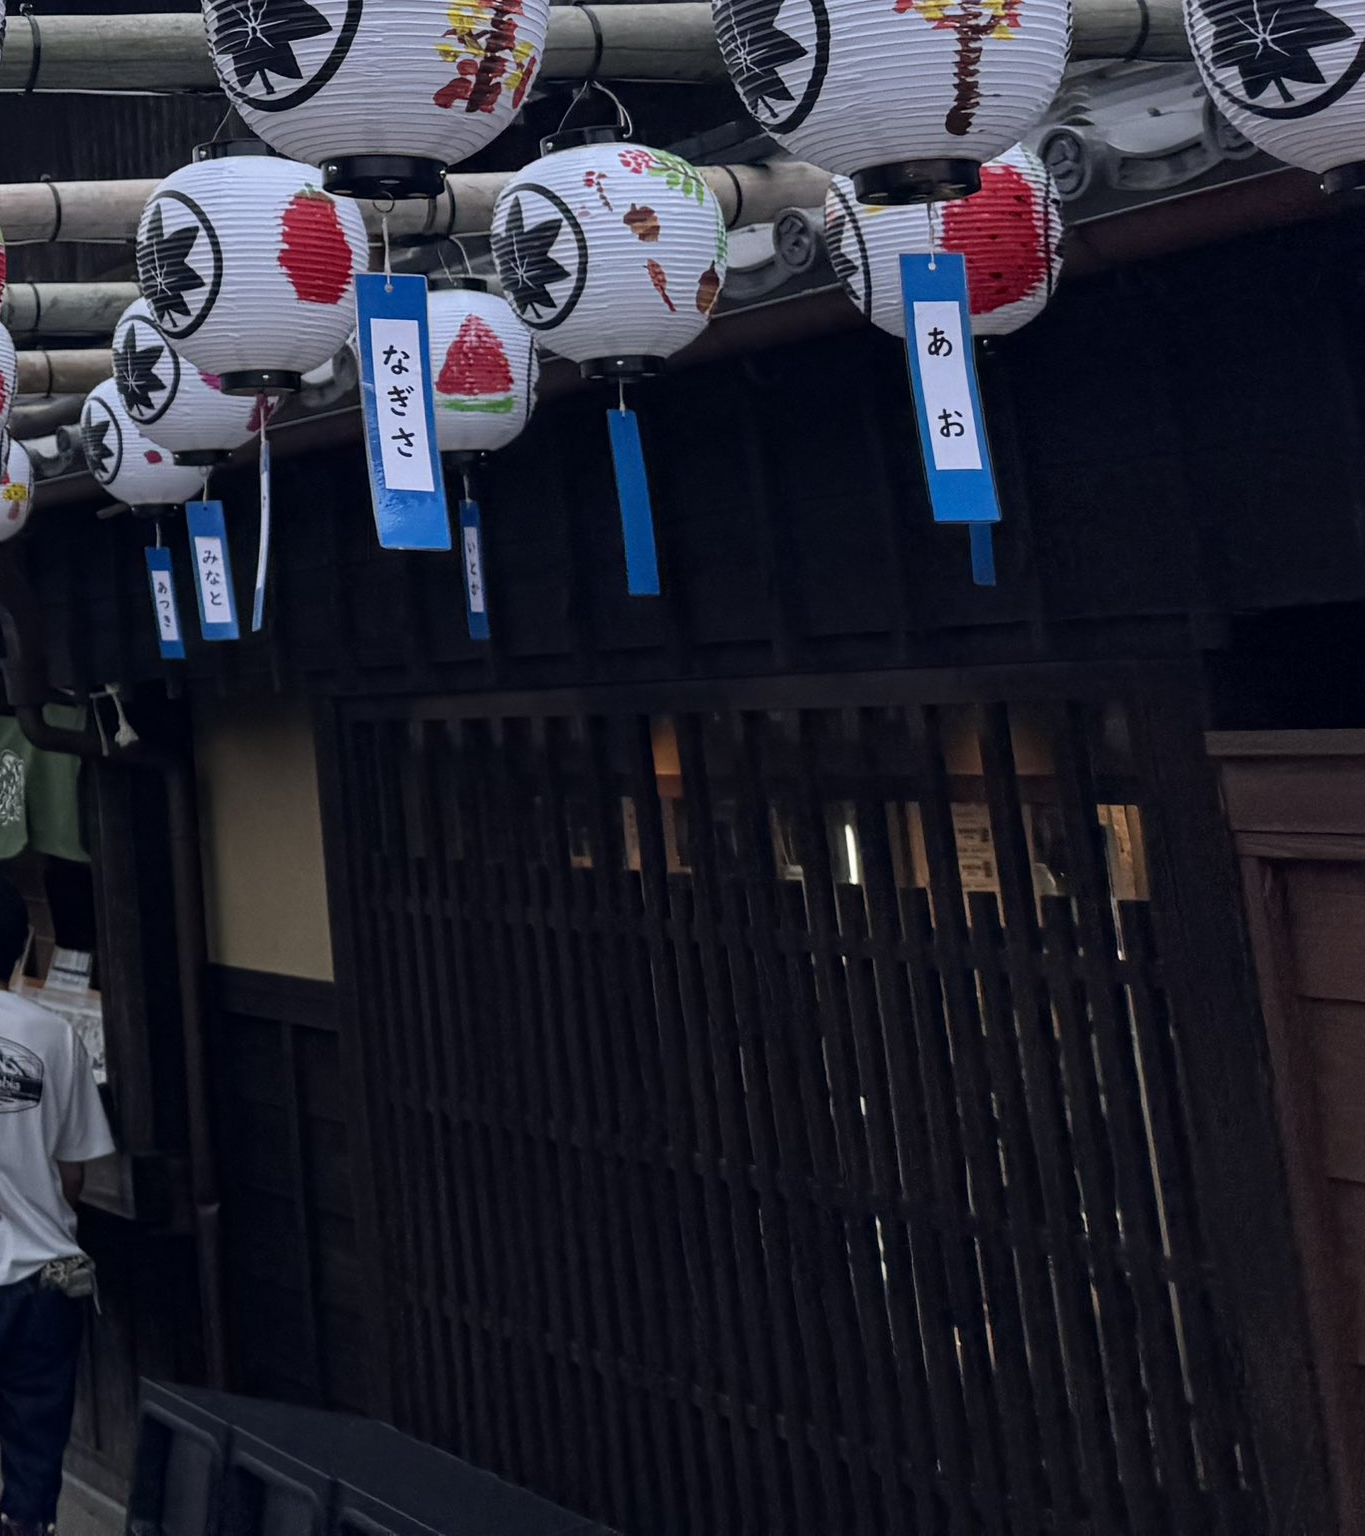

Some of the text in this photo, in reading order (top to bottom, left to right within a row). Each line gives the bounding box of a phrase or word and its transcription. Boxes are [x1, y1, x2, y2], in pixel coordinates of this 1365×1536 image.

[382, 344, 416, 459] なぎさ
[926, 327, 965, 439] あお
[157, 581, 172, 628] あつき
[202, 550, 222, 606] みなと
